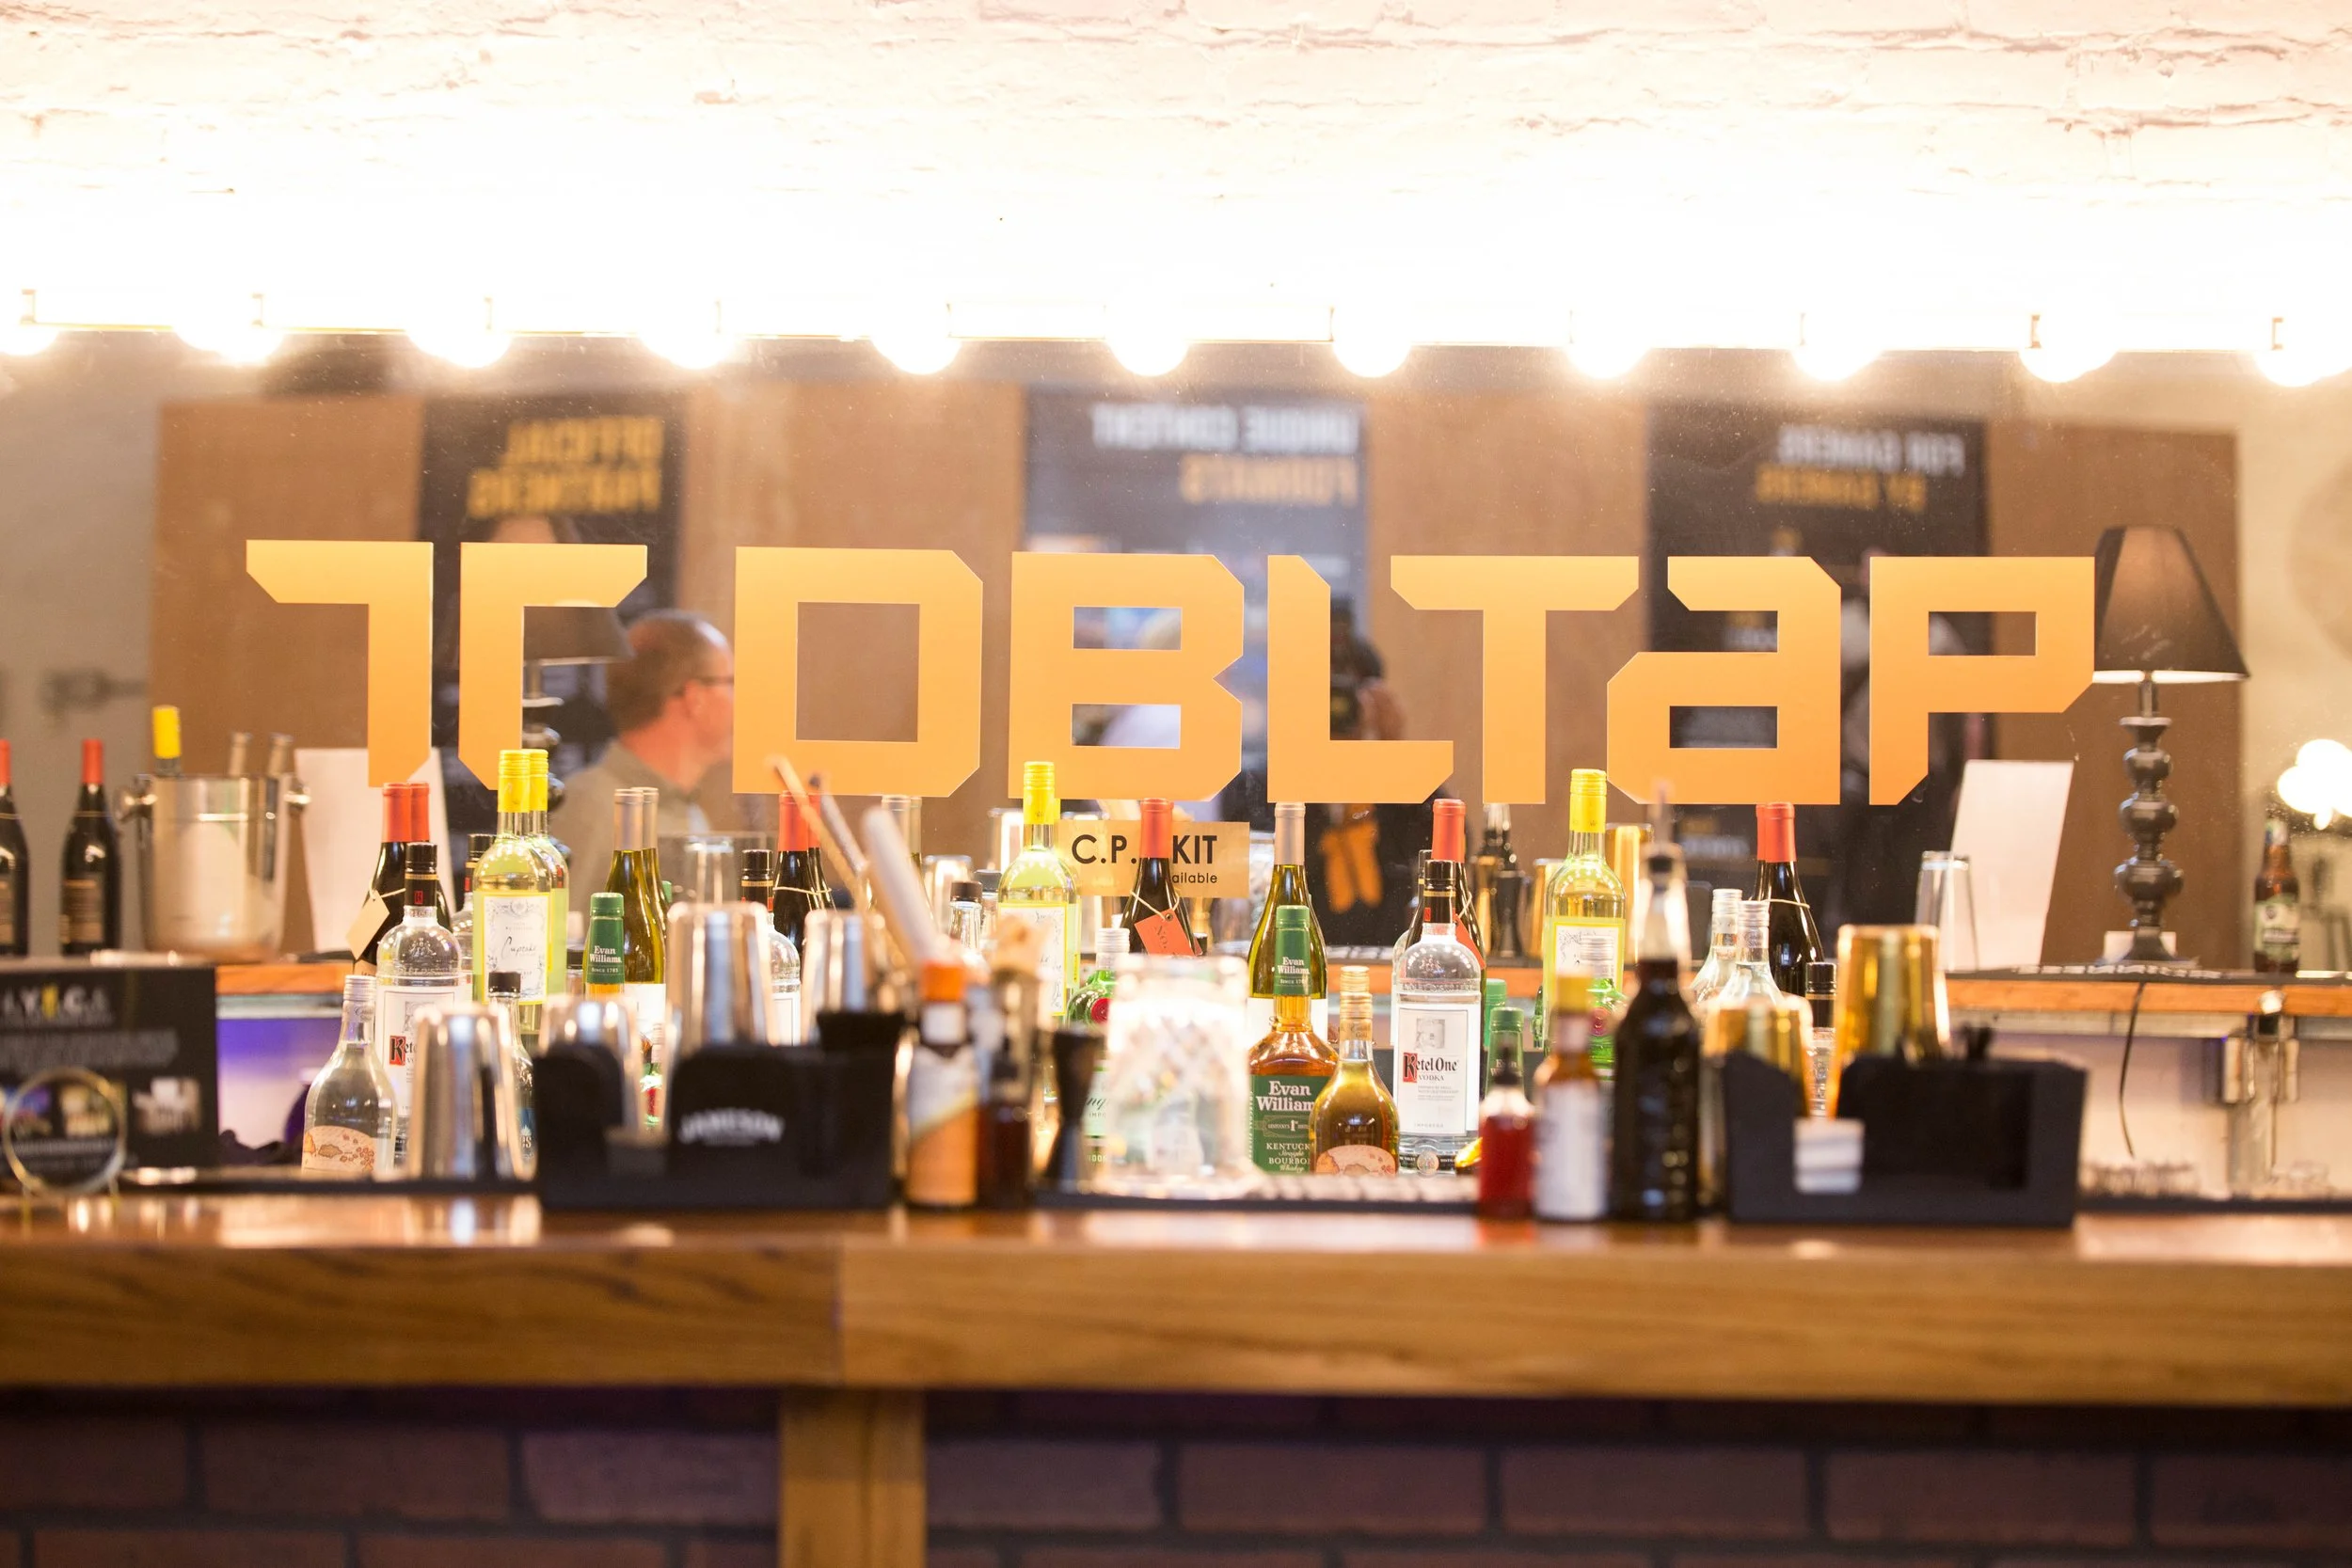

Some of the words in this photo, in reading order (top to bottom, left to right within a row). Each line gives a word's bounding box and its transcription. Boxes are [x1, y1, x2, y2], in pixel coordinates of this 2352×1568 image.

[1072, 834, 1136, 863] C.P.
[1172, 835, 1217, 863] KIT
[1172, 872, 1217, 883] ailable
[594, 945, 616, 955] Evan
[1282, 957, 1304, 965] Evan
[1404, 1053, 1433, 1081] Ketel
[1436, 1057, 1457, 1071] One
[1269, 1081, 1311, 1096] Evan
[1256, 1097, 1314, 1111] William
